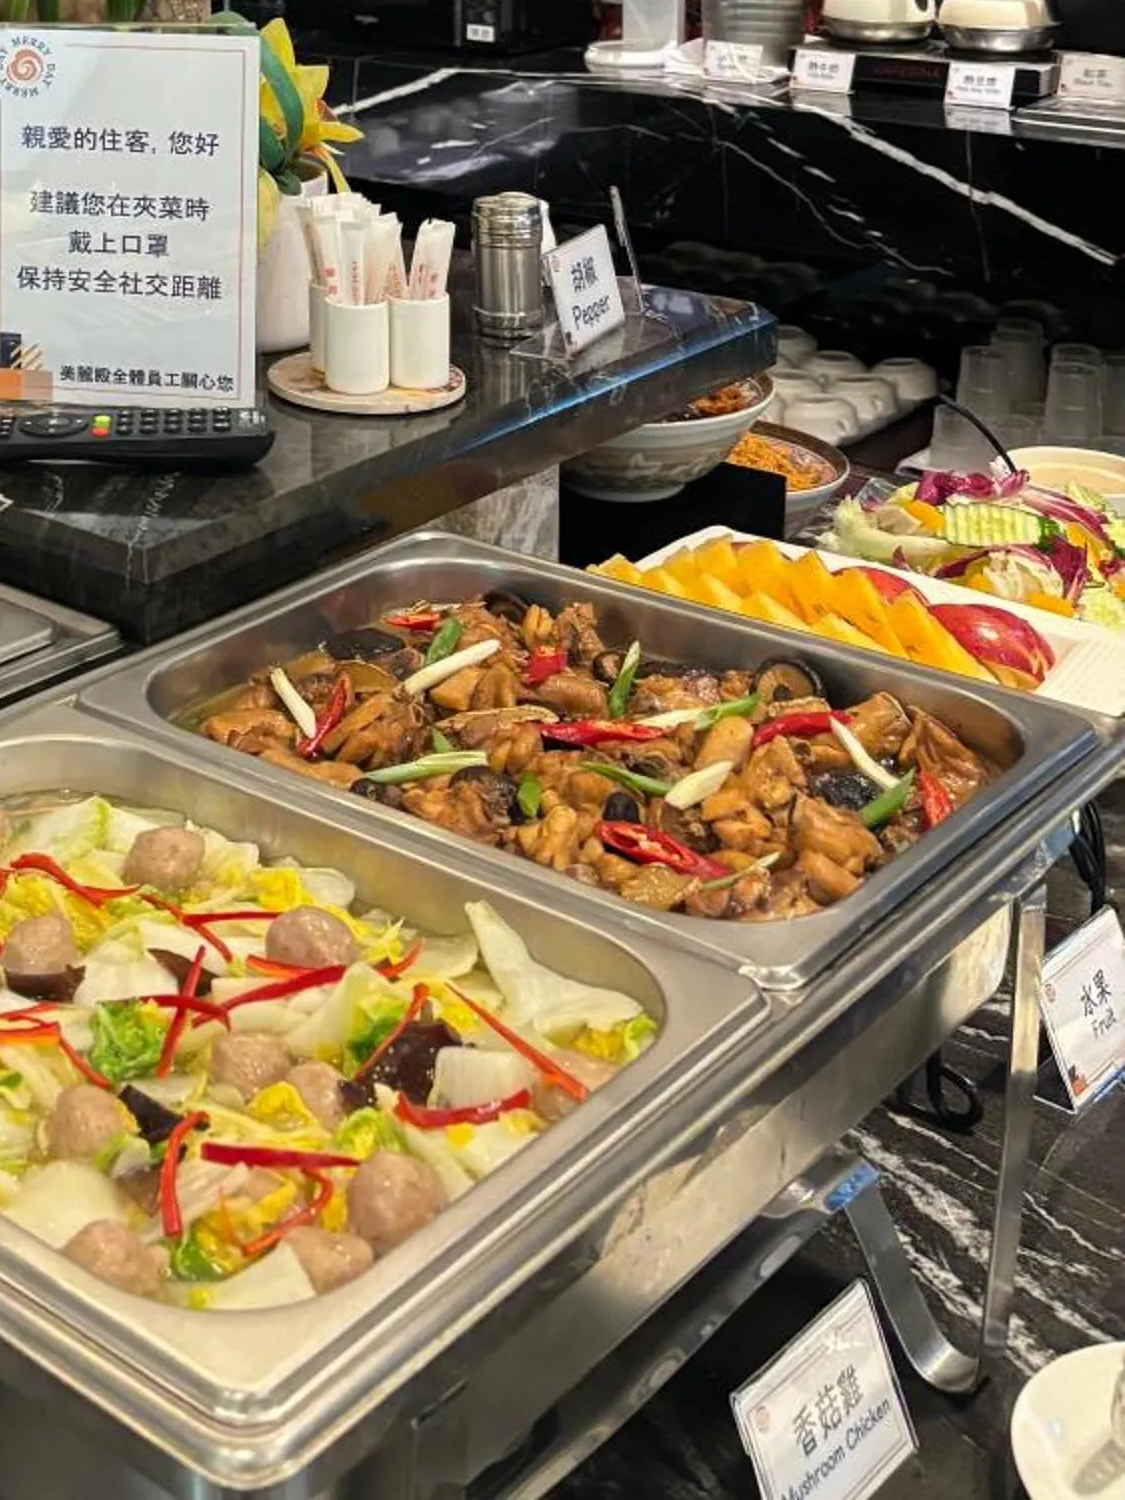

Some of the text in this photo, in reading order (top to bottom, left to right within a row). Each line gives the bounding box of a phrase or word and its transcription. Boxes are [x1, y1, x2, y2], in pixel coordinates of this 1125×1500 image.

[29, 190, 210, 220] 建議您在夾菜時
[68, 230, 169, 258] 戴上口罩
[17, 266, 222, 300] 保持安全社交距離
[572, 295, 610, 331] Pepper
[1081, 969, 1112, 1017] 水果
[846, 1398, 890, 1450] Chicken
